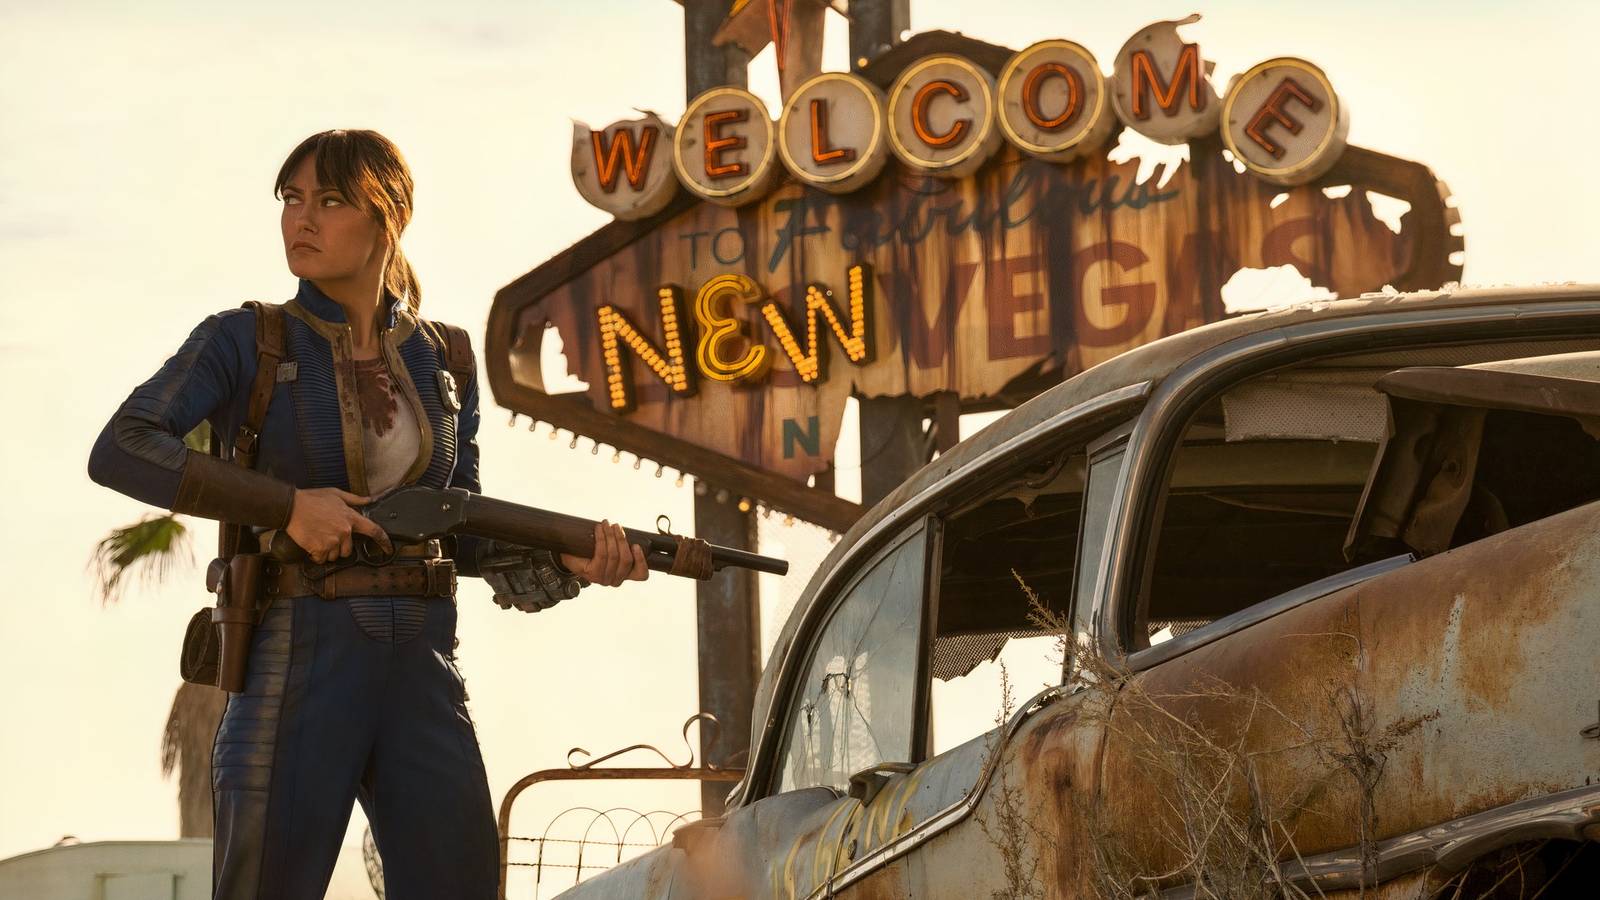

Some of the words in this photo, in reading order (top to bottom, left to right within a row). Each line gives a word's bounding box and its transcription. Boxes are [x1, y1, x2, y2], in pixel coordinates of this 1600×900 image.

[591, 43, 1323, 193] WELCOME
[680, 227, 745, 270] TO
[769, 167, 1179, 273] Fabulus
[598, 264, 874, 412] NEW
